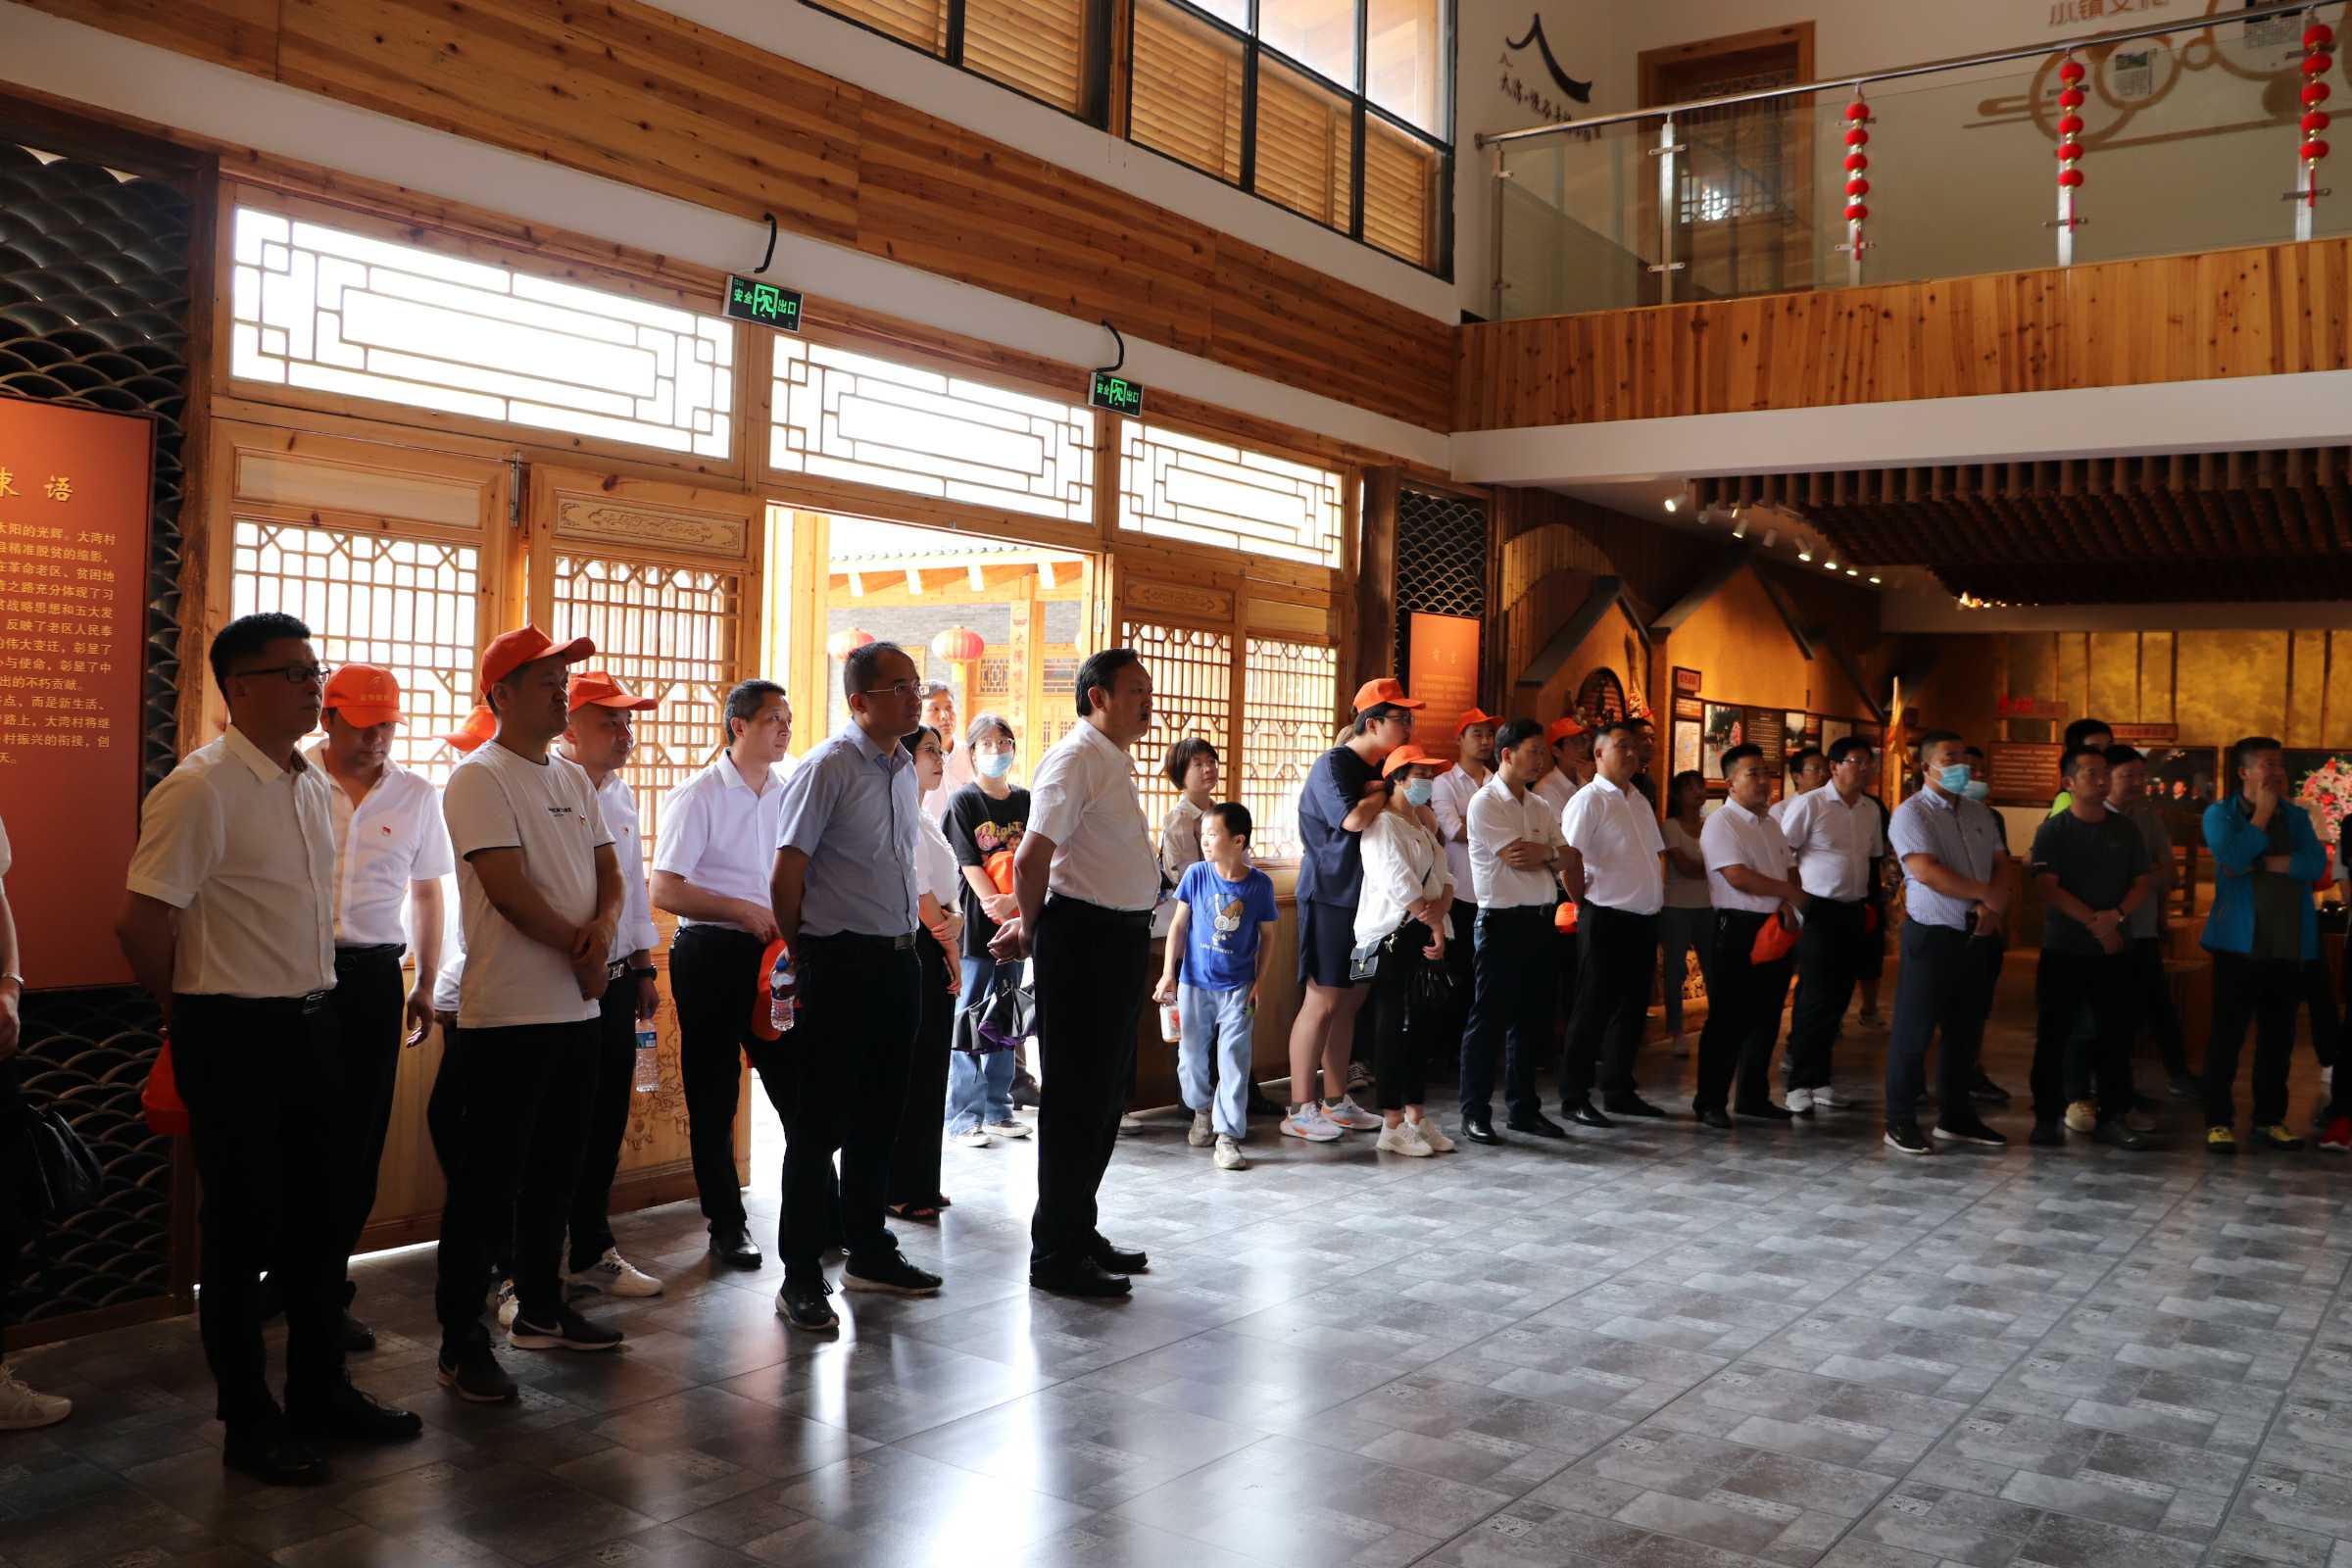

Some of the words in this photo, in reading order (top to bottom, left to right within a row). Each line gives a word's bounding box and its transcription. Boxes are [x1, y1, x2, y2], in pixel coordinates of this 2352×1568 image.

[734, 288, 753, 305] 安全
[777, 299, 797, 316] 出口
[0, 695, 105, 710] 点，而是新生活、
[0, 713, 111, 729] 路上，大湾村将继
